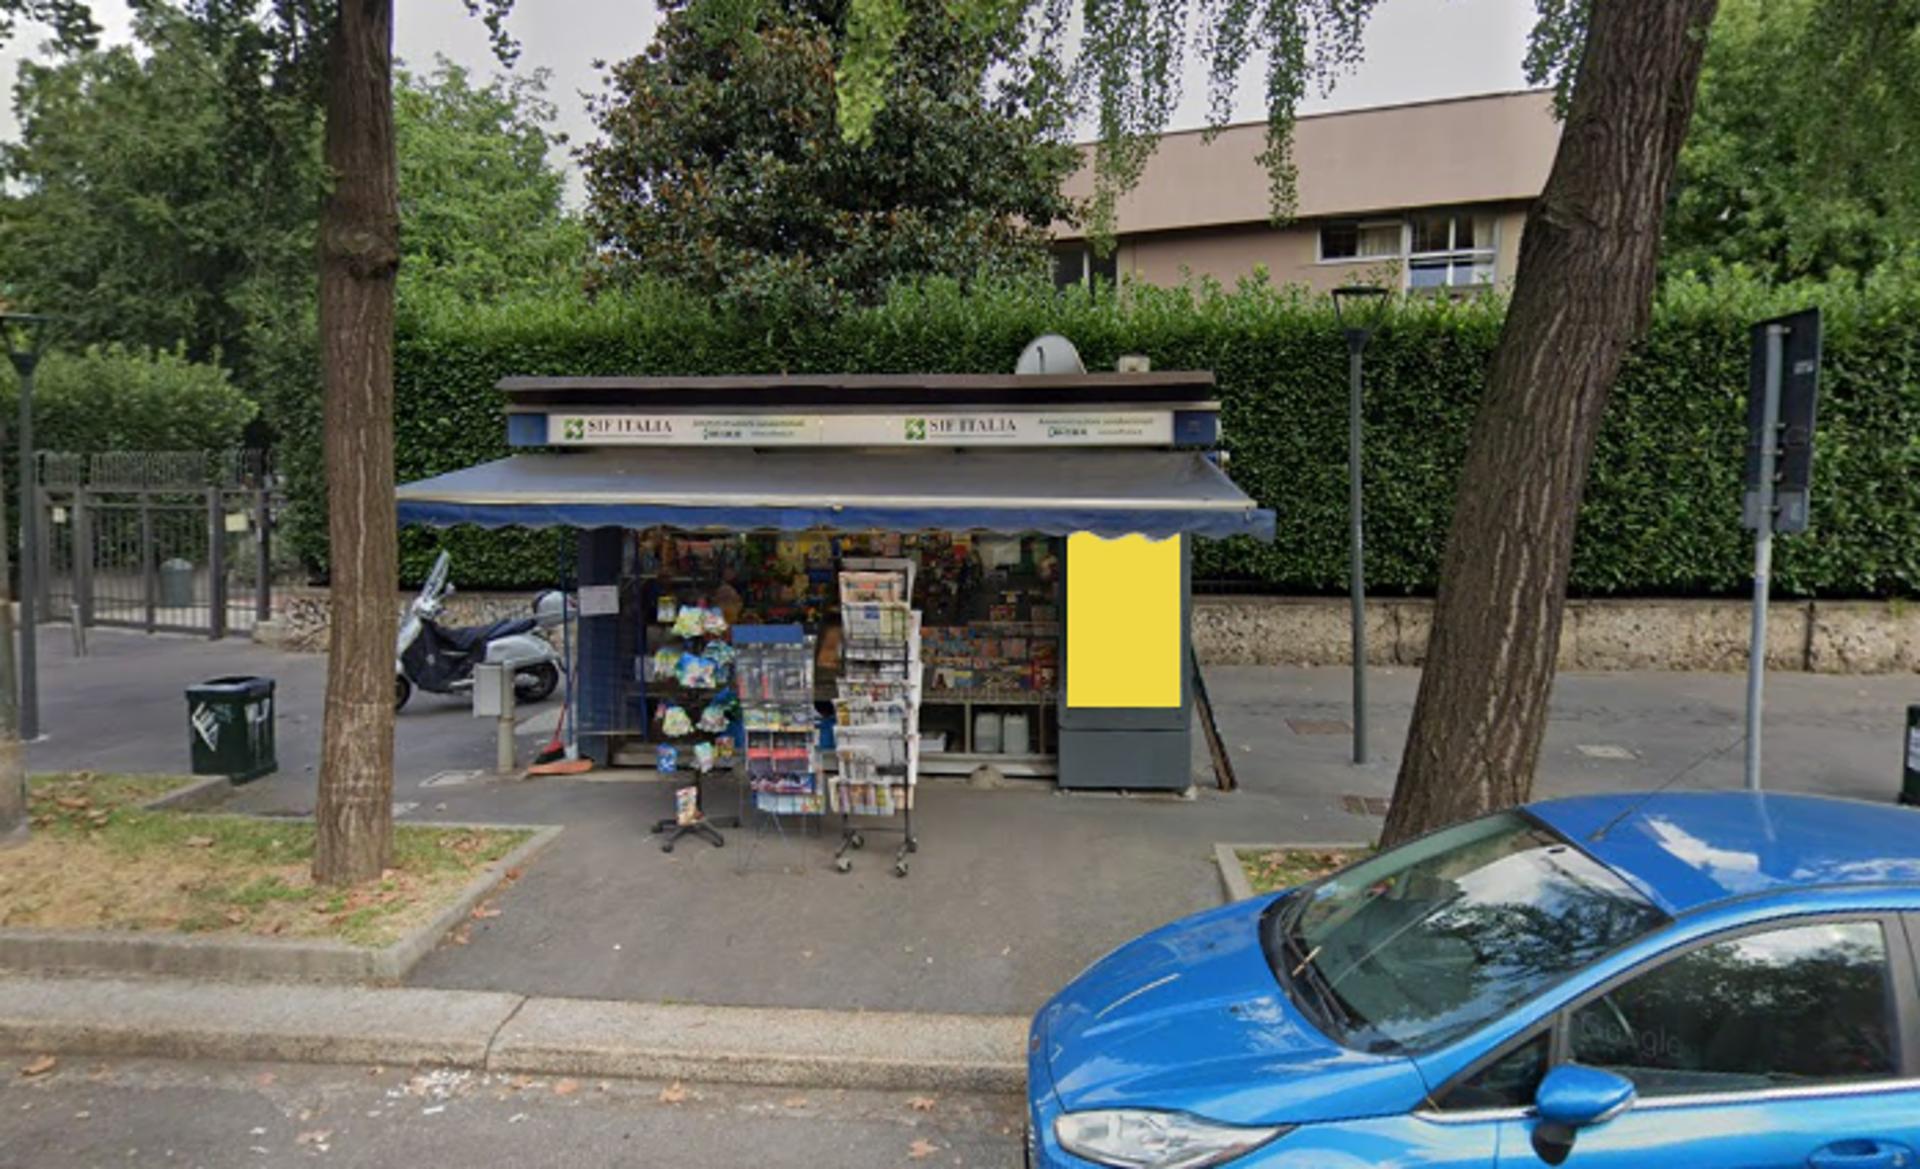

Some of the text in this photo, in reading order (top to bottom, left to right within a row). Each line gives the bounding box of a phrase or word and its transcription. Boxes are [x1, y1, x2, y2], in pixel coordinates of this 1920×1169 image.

[587, 418, 674, 433] SIF ITALIA
[959, 418, 1017, 433] ITALIA
